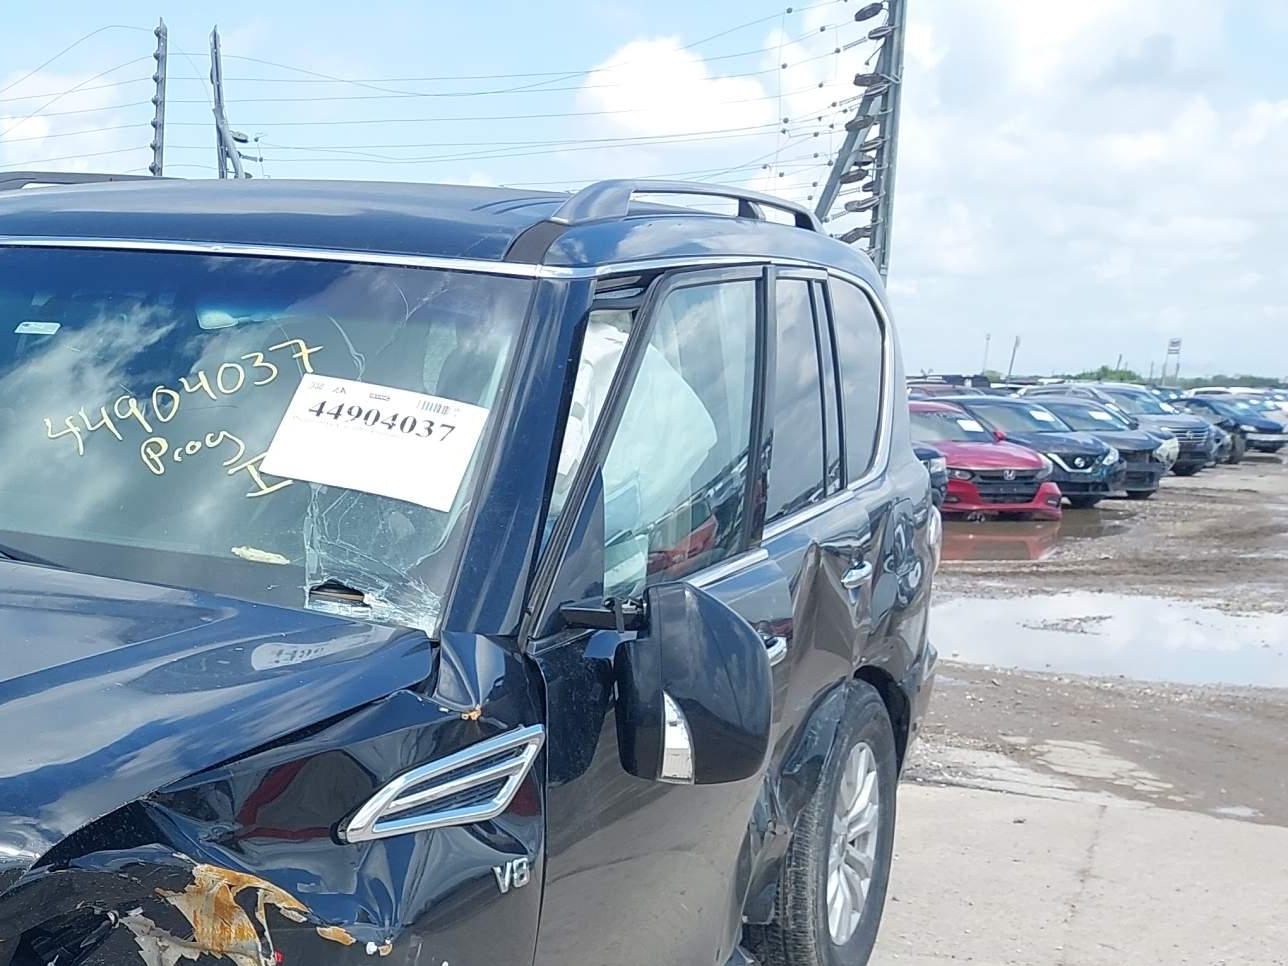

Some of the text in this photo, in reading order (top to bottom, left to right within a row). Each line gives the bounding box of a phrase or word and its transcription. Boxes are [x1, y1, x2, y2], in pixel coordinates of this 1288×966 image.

[44, 338, 323, 455] 44904037
[308, 400, 456, 442] 44904037
[492, 857, 530, 893] V8
